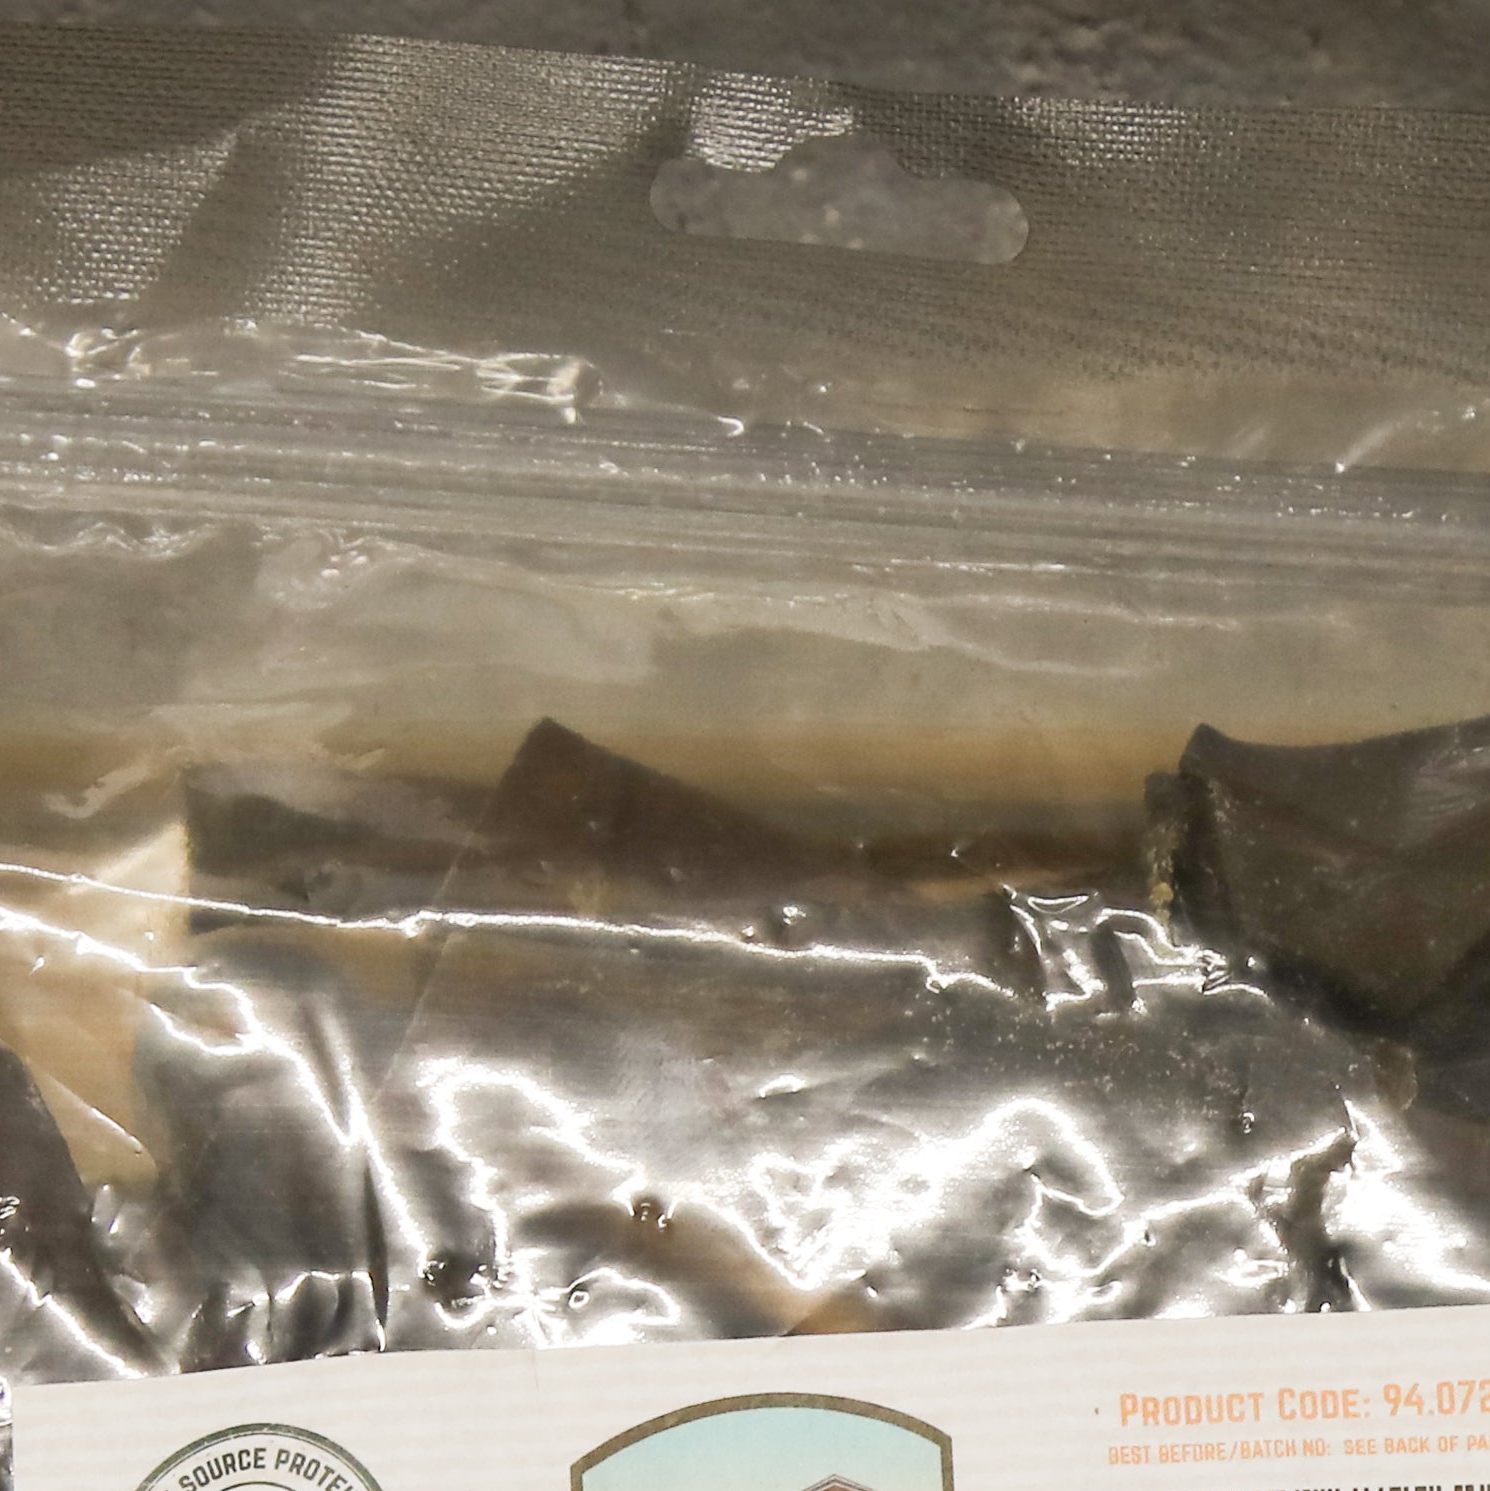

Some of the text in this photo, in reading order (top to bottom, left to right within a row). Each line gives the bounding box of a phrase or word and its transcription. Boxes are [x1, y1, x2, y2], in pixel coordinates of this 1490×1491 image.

[1119, 1392, 1264, 1427] PRODUCT
[1277, 1388, 1371, 1420] CODE:
[1108, 1445, 1150, 1465] BEST
[1159, 1438, 1296, 1464] BEFORE/BATCH
[1302, 1438, 1331, 1457] NO:
[1344, 1439, 1377, 1455] SEE
[1384, 1437, 1429, 1454] BACK
[1438, 1435, 1459, 1452] OF
